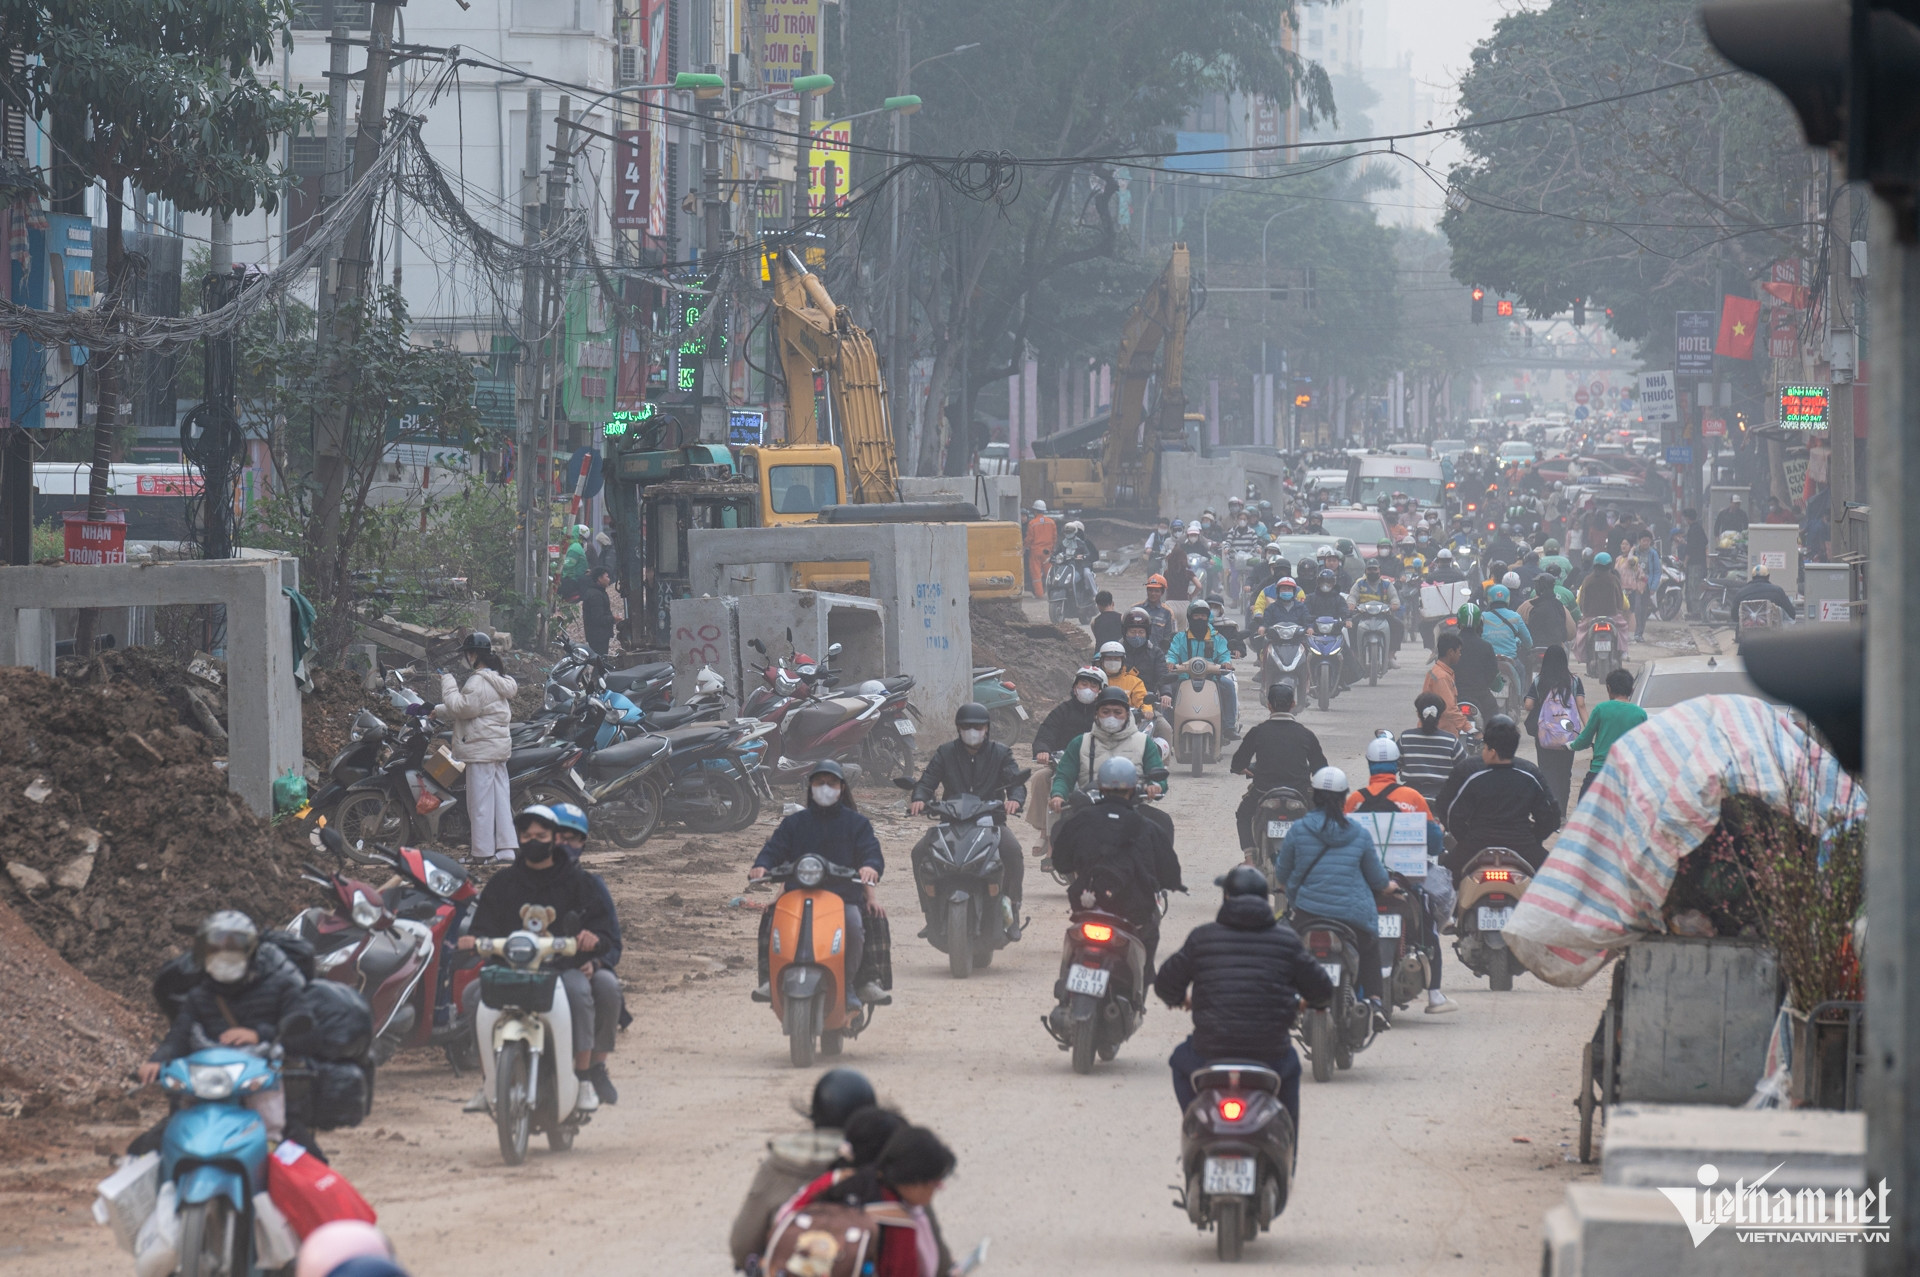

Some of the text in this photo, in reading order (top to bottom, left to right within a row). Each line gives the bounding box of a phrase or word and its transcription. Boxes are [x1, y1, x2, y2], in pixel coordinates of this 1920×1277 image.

[783, 11, 816, 39] TRỘN
[762, 42, 789, 63] CƠM
[1679, 337, 1712, 352] HOTEL
[82, 524, 111, 544] NHẬN
[1379, 926, 1398, 937] 2.22
[1479, 919, 1506, 929] 300.9
